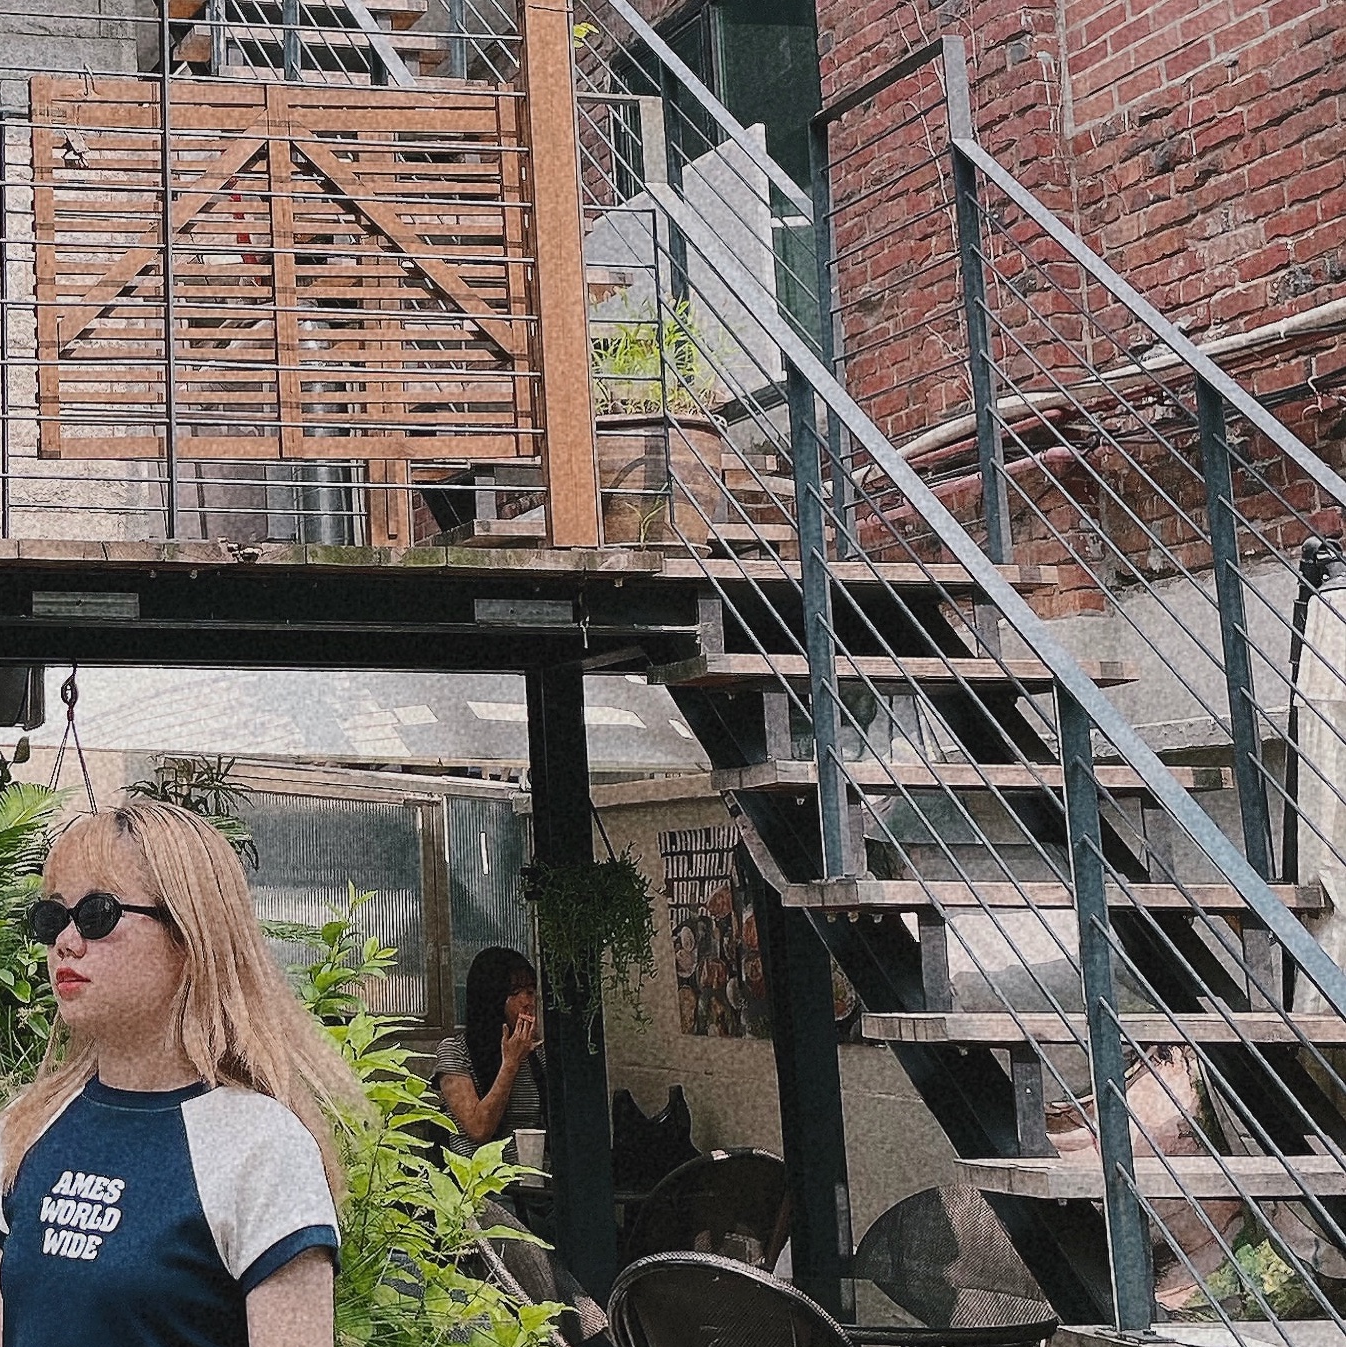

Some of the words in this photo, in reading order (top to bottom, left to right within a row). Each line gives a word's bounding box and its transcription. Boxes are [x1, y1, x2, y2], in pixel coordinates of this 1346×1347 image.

[51, 1170, 126, 1204] AMES
[39, 1196, 122, 1233] WORLD
[42, 1227, 103, 1260] WIDE
